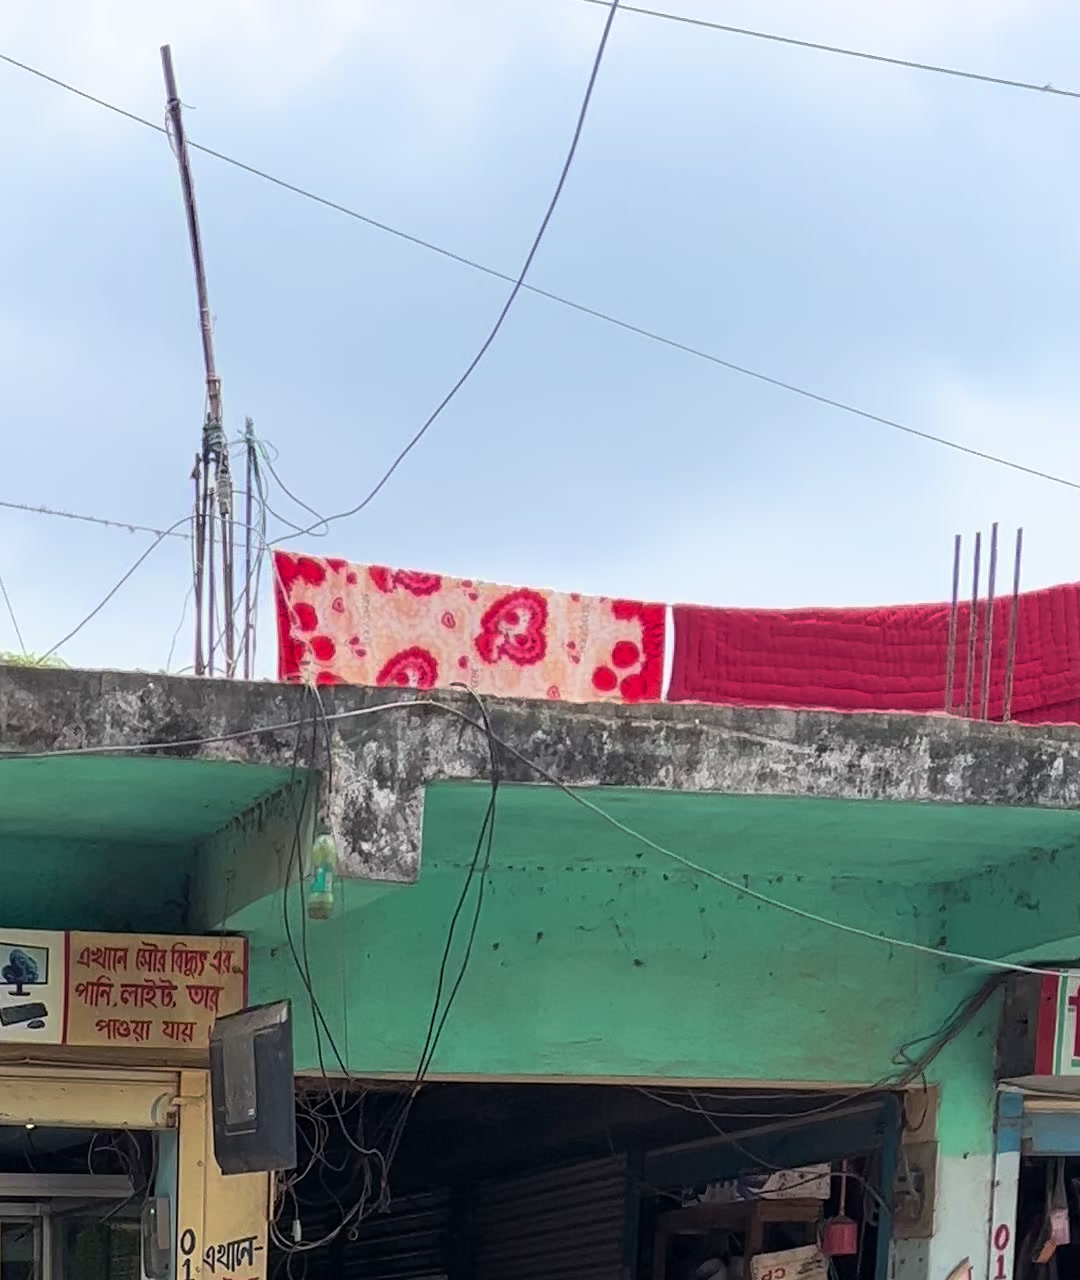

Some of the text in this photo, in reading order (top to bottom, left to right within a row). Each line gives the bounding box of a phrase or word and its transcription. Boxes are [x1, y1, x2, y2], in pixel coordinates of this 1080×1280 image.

[76, 945, 129, 974] এখানে
[186, 984, 224, 1013] তার
[95, 1018, 152, 1043] পাওয়া
